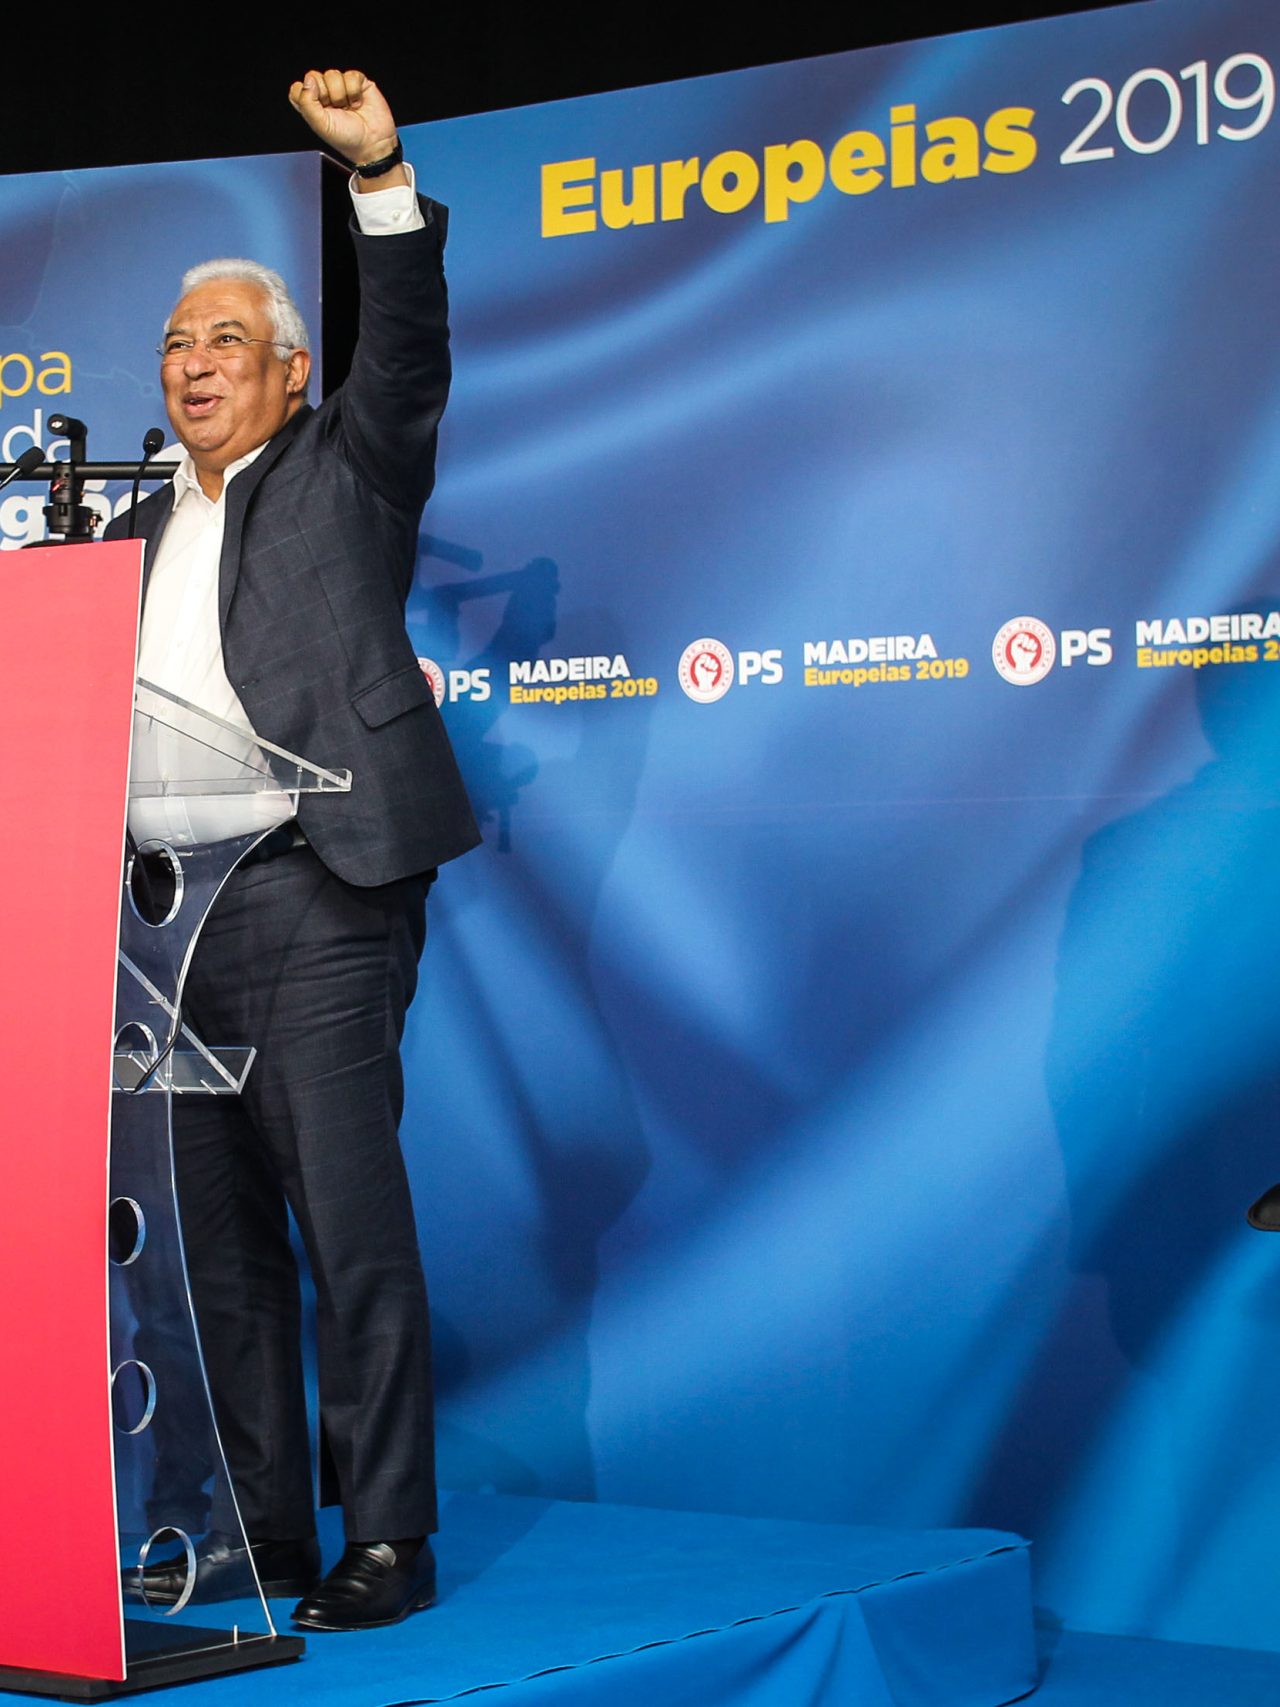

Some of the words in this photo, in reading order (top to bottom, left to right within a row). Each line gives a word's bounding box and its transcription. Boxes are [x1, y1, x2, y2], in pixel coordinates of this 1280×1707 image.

[540, 103, 1038, 239] Europeias
[1059, 53, 1276, 165] 2019
[1135, 611, 1280, 646] MADEIRA
[803, 633, 938, 666] MADEIRA
[1061, 628, 1113, 667] PS
[1136, 642, 1259, 669] Europeias
[1263, 640, 1280, 662] 2
[509, 654, 631, 684] MADEIRA
[738, 649, 784, 686] PS
[804, 662, 912, 687] Europeias
[916, 658, 969, 680] 2019
[448, 668, 491, 702] PS
[509, 681, 607, 705] Europeias
[610, 677, 659, 698] 2019
